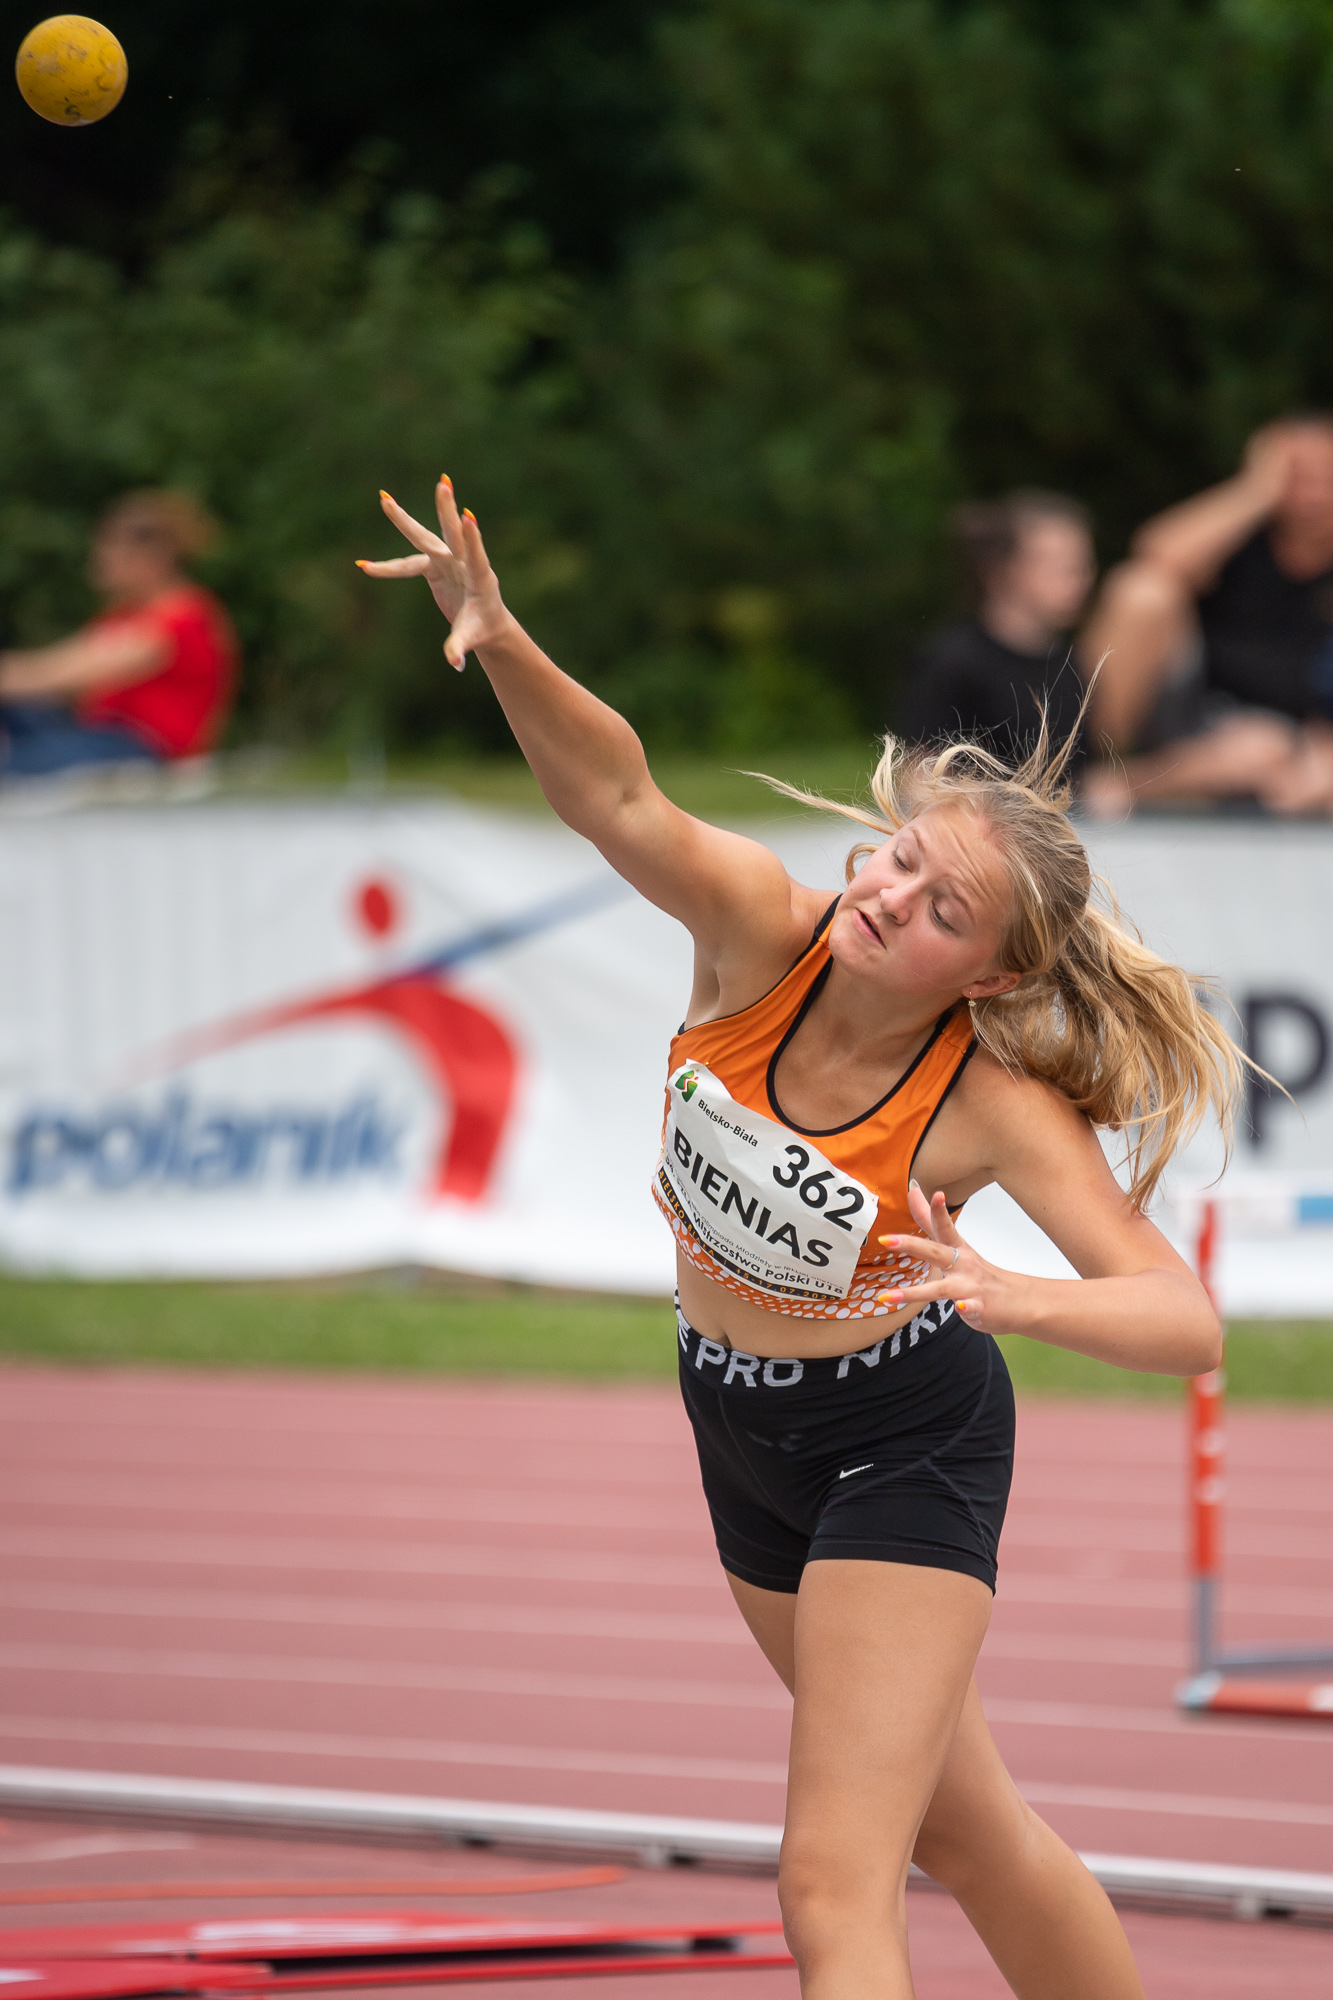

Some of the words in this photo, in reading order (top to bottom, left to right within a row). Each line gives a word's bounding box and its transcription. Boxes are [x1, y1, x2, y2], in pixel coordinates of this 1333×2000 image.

[697, 1098, 759, 1148] Bielsko-Biała
[657, 1169, 715, 1257] BIELSKO-BIAŁA
[673, 1126, 834, 1268] BIENIAS
[772, 1144, 865, 1232] 362
[692, 1212, 761, 1273] Mistrzostwa
[765, 1268, 810, 1286] Polski
[694, 1337, 805, 1388] PRO
[836, 1298, 955, 1380] NIKE
